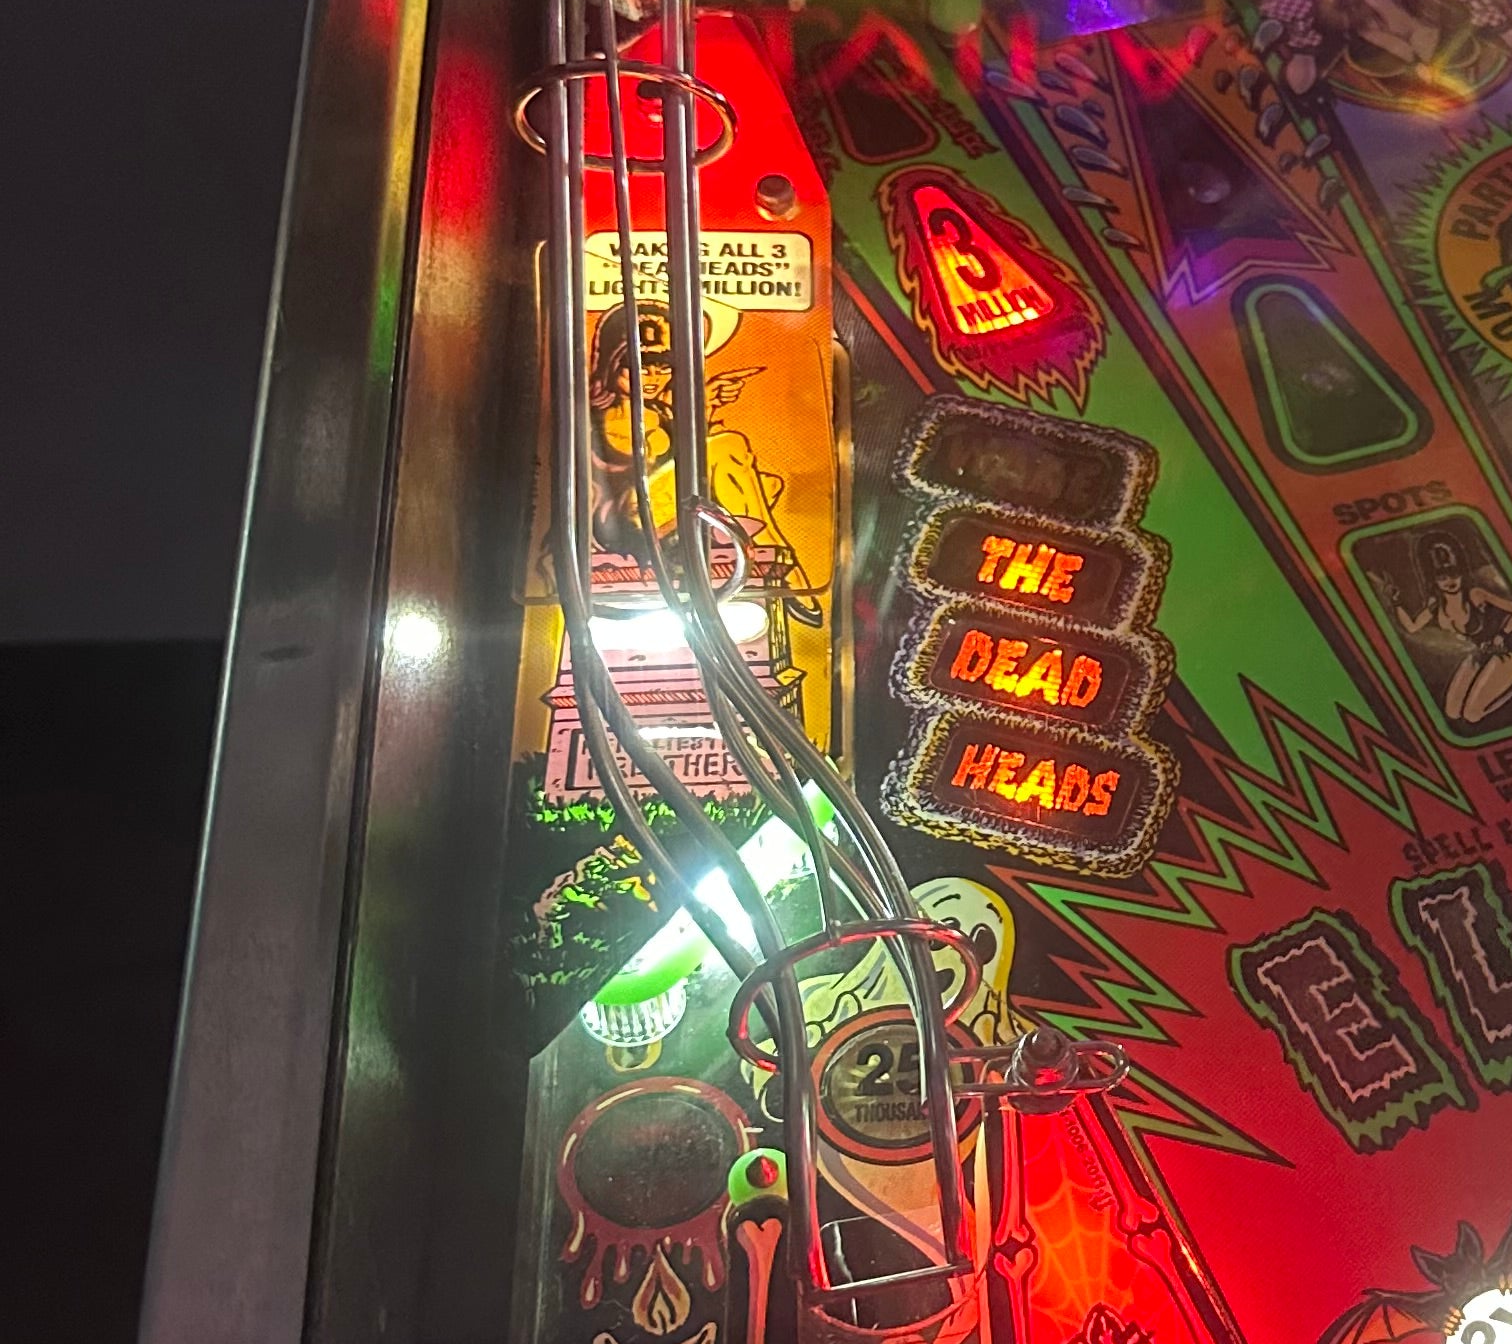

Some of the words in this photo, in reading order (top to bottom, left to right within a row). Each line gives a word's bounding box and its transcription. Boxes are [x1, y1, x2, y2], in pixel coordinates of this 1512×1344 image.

[719, 243, 764, 258] ALL
[771, 244, 788, 258] 3
[928, 207, 1003, 293] 3
[956, 285, 1046, 329] MILLION
[1332, 479, 1456, 527] SPOTS
[977, 533, 1085, 604] THE
[950, 628, 1103, 709] DEAD
[951, 743, 1121, 817] HEADS
[1402, 827, 1493, 872] SPELL
